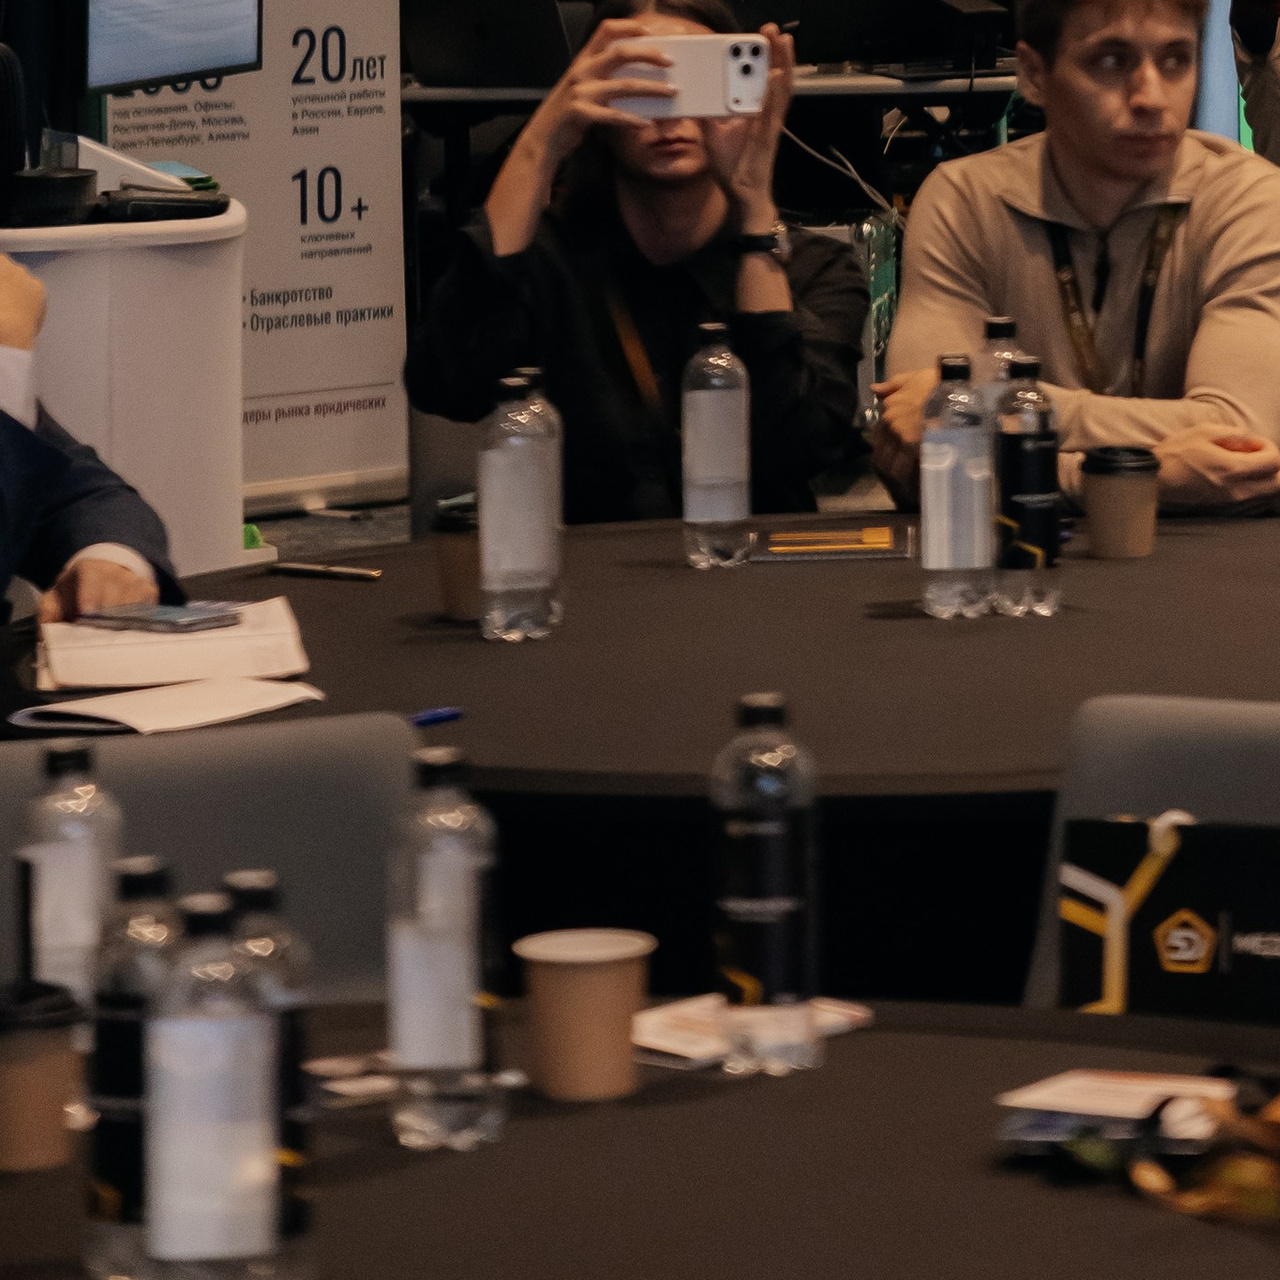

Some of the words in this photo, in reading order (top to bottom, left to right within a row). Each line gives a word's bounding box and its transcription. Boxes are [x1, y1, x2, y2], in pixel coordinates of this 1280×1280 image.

[291, 25, 347, 85] 20
[349, 54, 387, 82] лет
[250, 286, 333, 308] Банкротство
[250, 311, 332, 335] Отраслевые
[336, 305, 394, 327] практики
[242, 408, 271, 426] деры
[275, 403, 311, 423] рынка
[313, 396, 387, 418] юридических
